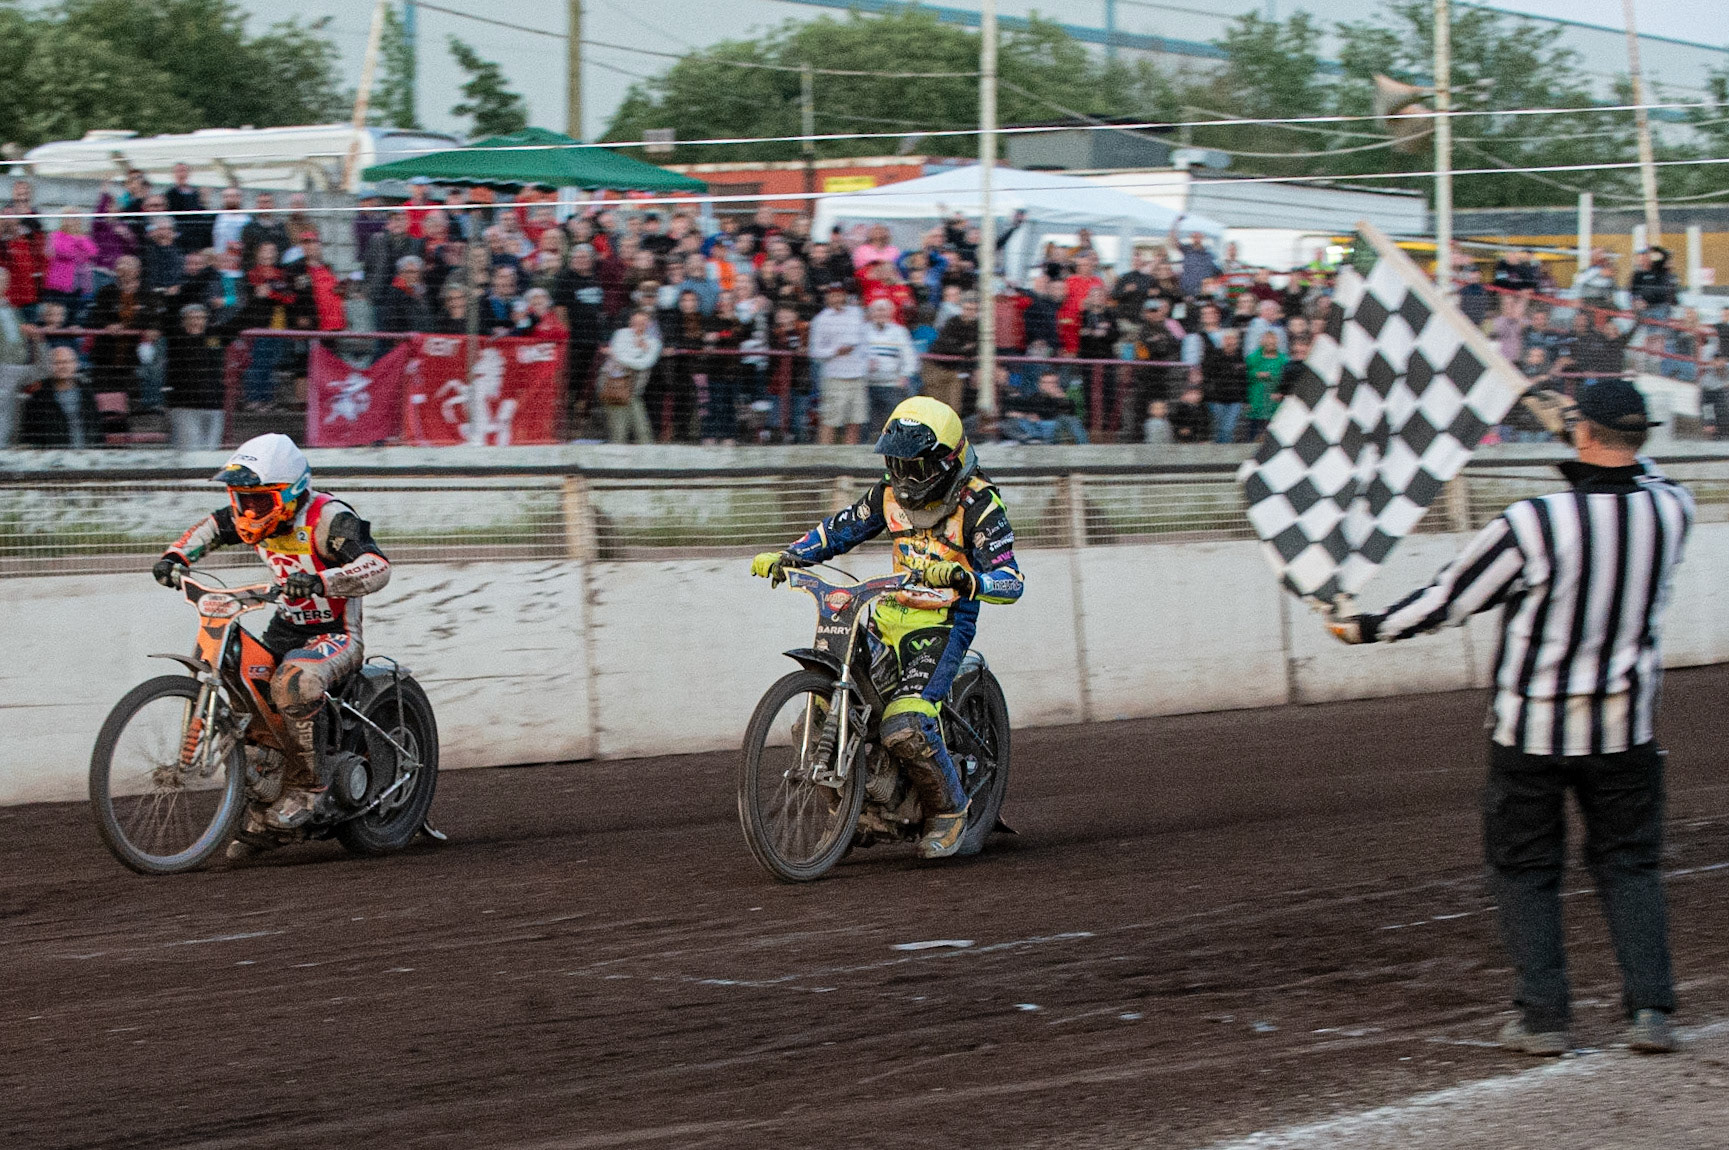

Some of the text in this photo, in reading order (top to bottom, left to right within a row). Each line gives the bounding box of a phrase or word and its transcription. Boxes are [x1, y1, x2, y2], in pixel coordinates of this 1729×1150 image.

[300, 531, 306, 540] 2
[293, 609, 332, 622] TERS
[817, 625, 852, 636] BARRY
